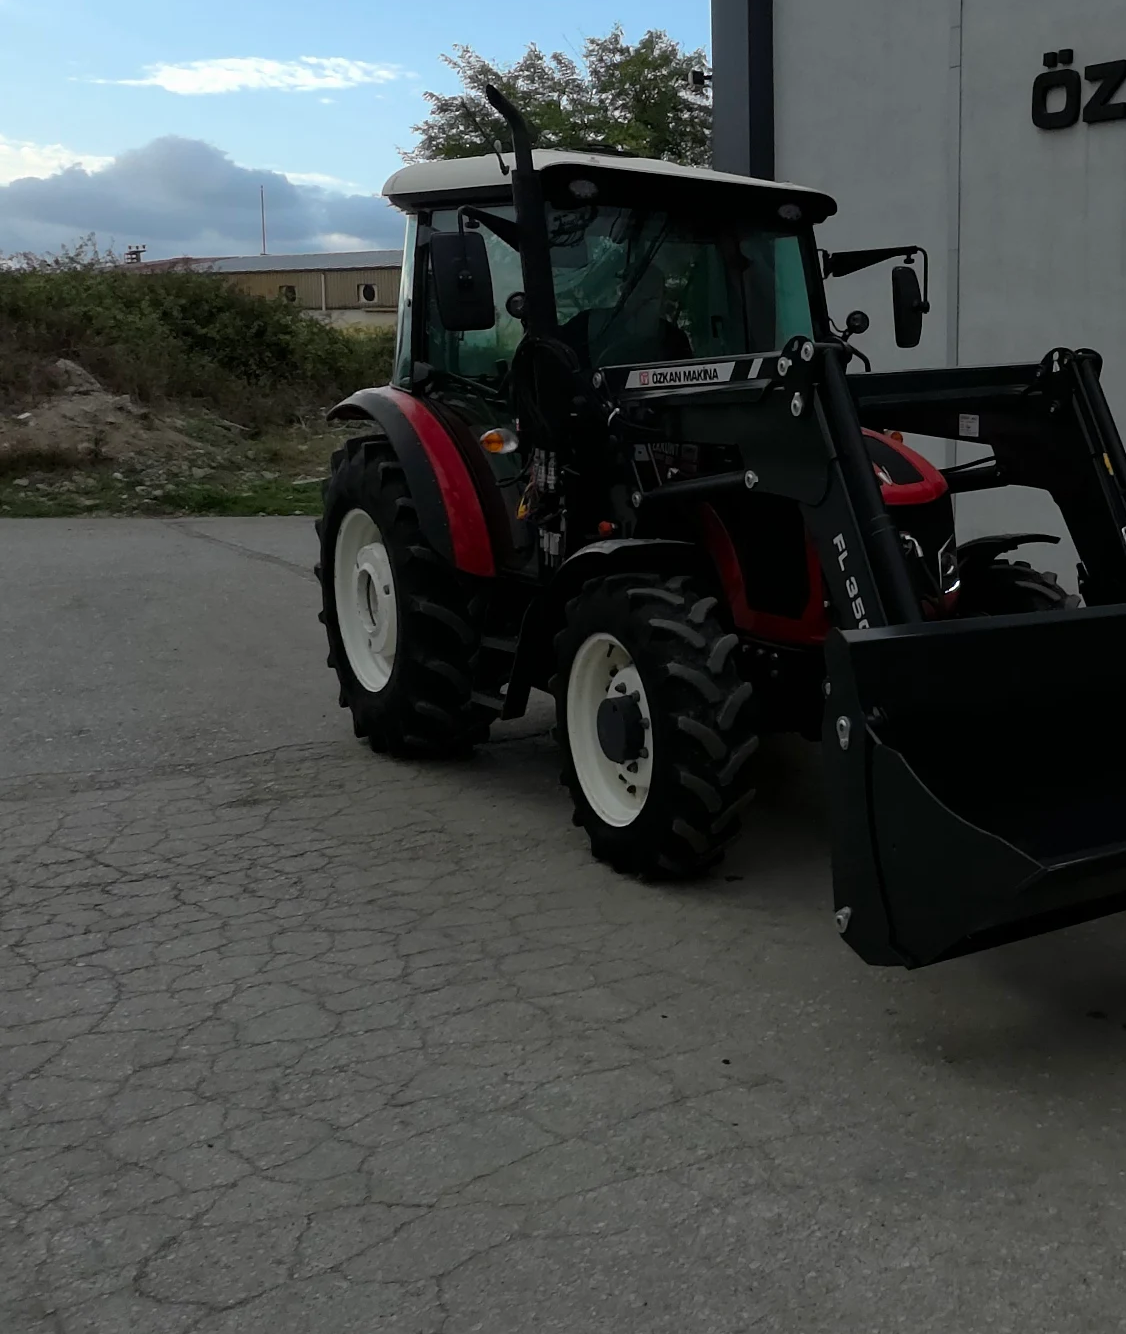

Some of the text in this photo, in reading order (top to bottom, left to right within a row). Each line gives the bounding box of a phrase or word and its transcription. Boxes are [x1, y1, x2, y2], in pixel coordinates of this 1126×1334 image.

[652, 371, 682, 384] ÖZKAN
[683, 366, 719, 382] MAKİNA
[832, 533, 848, 572] FL
